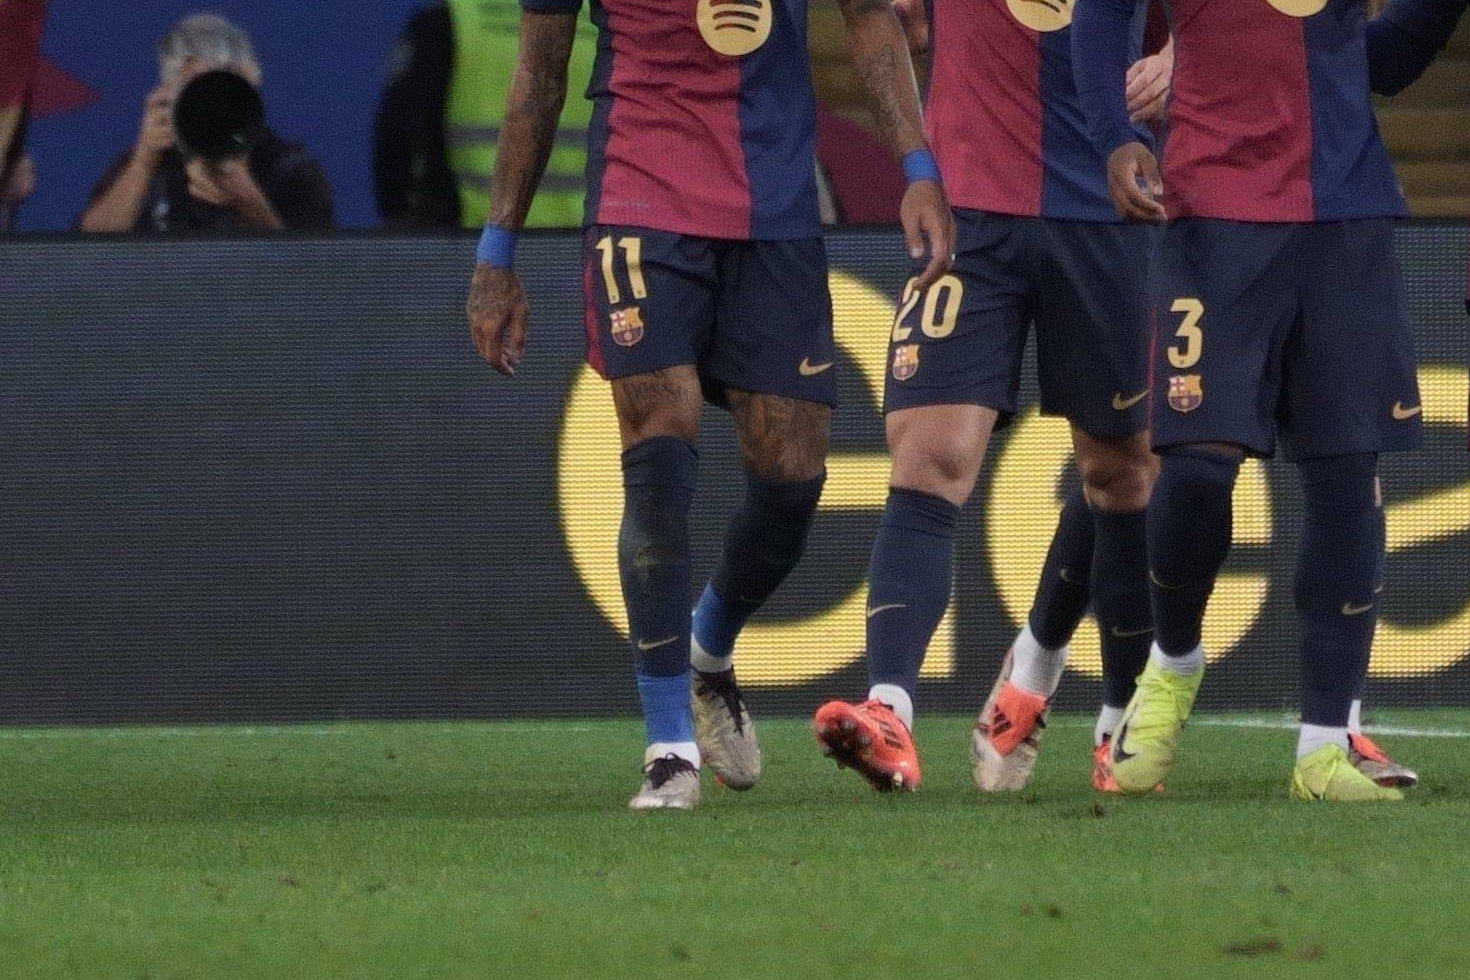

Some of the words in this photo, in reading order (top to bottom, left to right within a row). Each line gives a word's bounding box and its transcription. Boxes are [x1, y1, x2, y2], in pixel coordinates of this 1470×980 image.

[595, 236, 647, 304] 11
[892, 274, 963, 342] 20
[1167, 298, 1204, 369] 3
